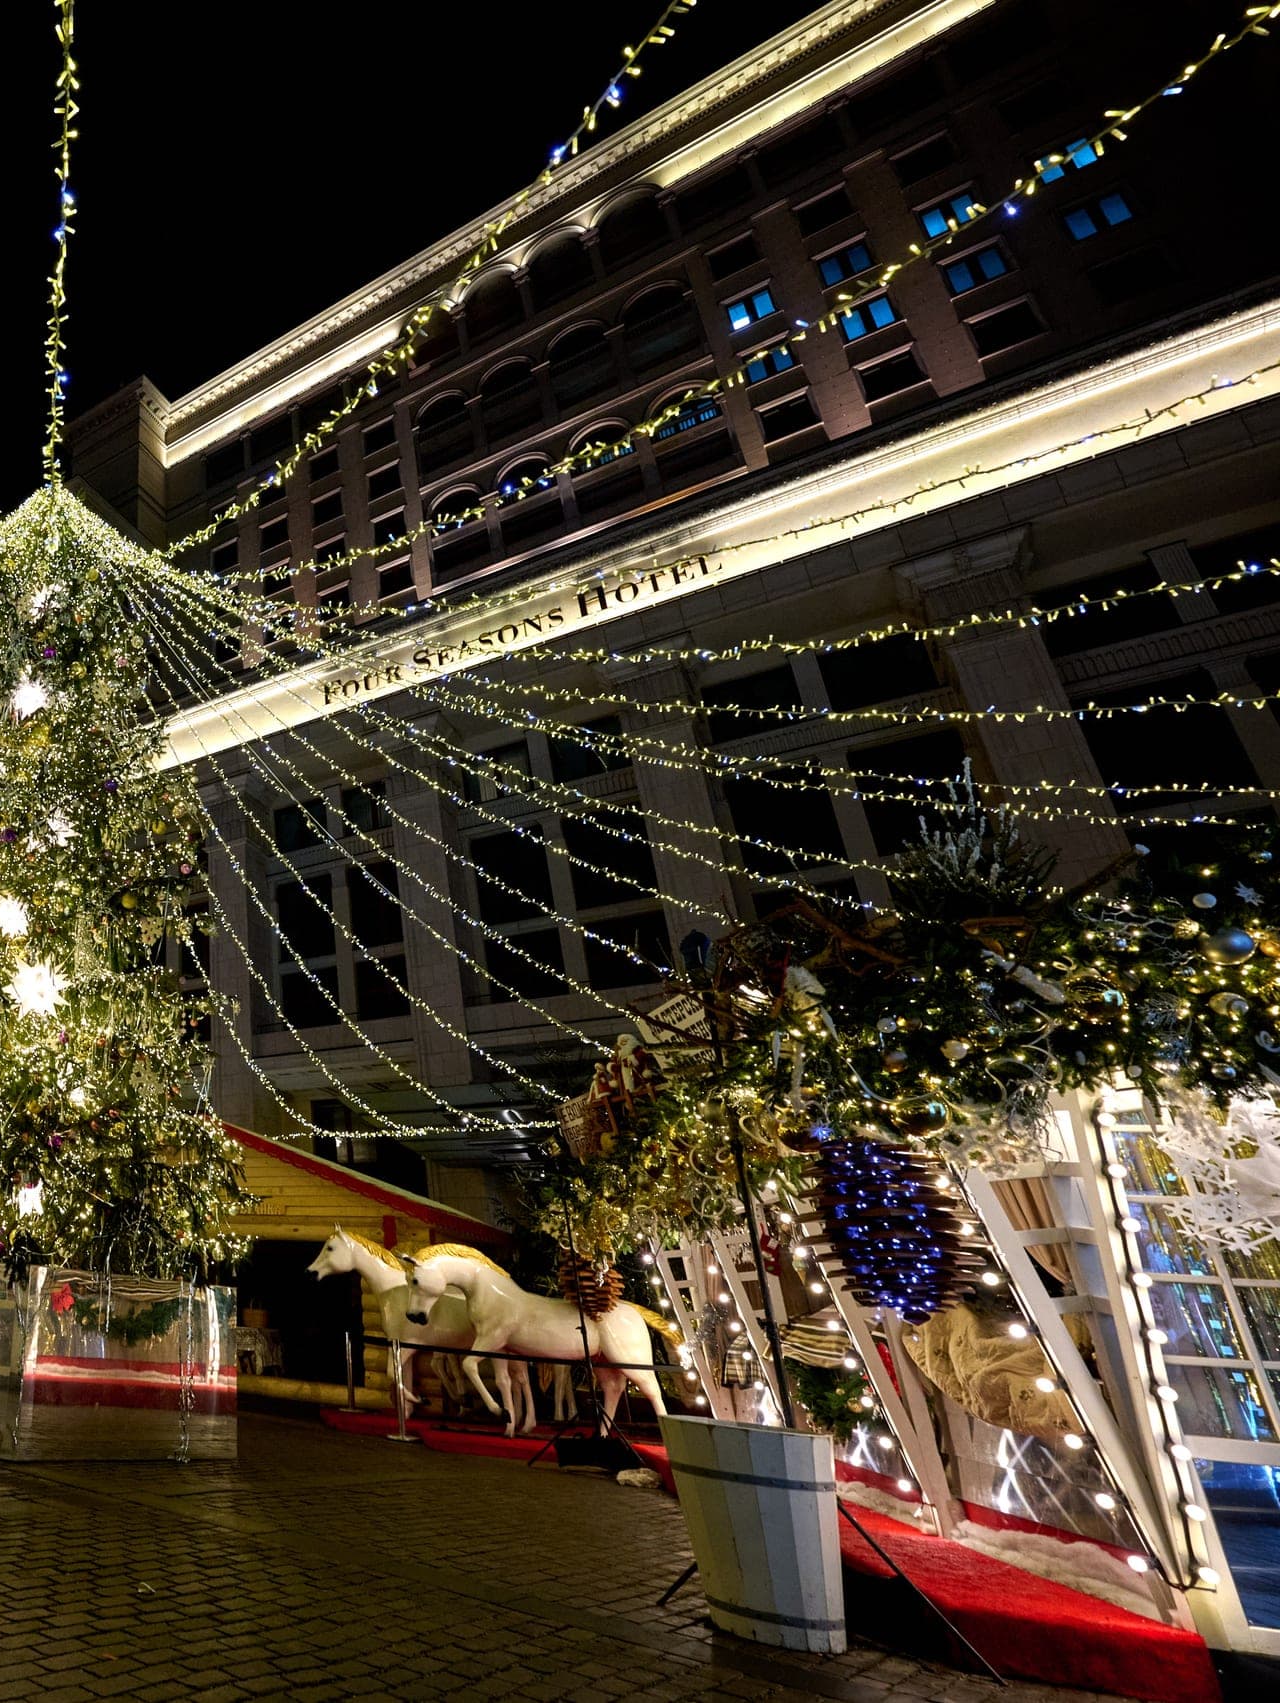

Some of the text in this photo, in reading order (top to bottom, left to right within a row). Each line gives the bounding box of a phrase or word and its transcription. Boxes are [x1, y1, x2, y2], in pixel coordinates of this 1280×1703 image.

[323, 555, 723, 705] FOUR SEASONS HOTEL
